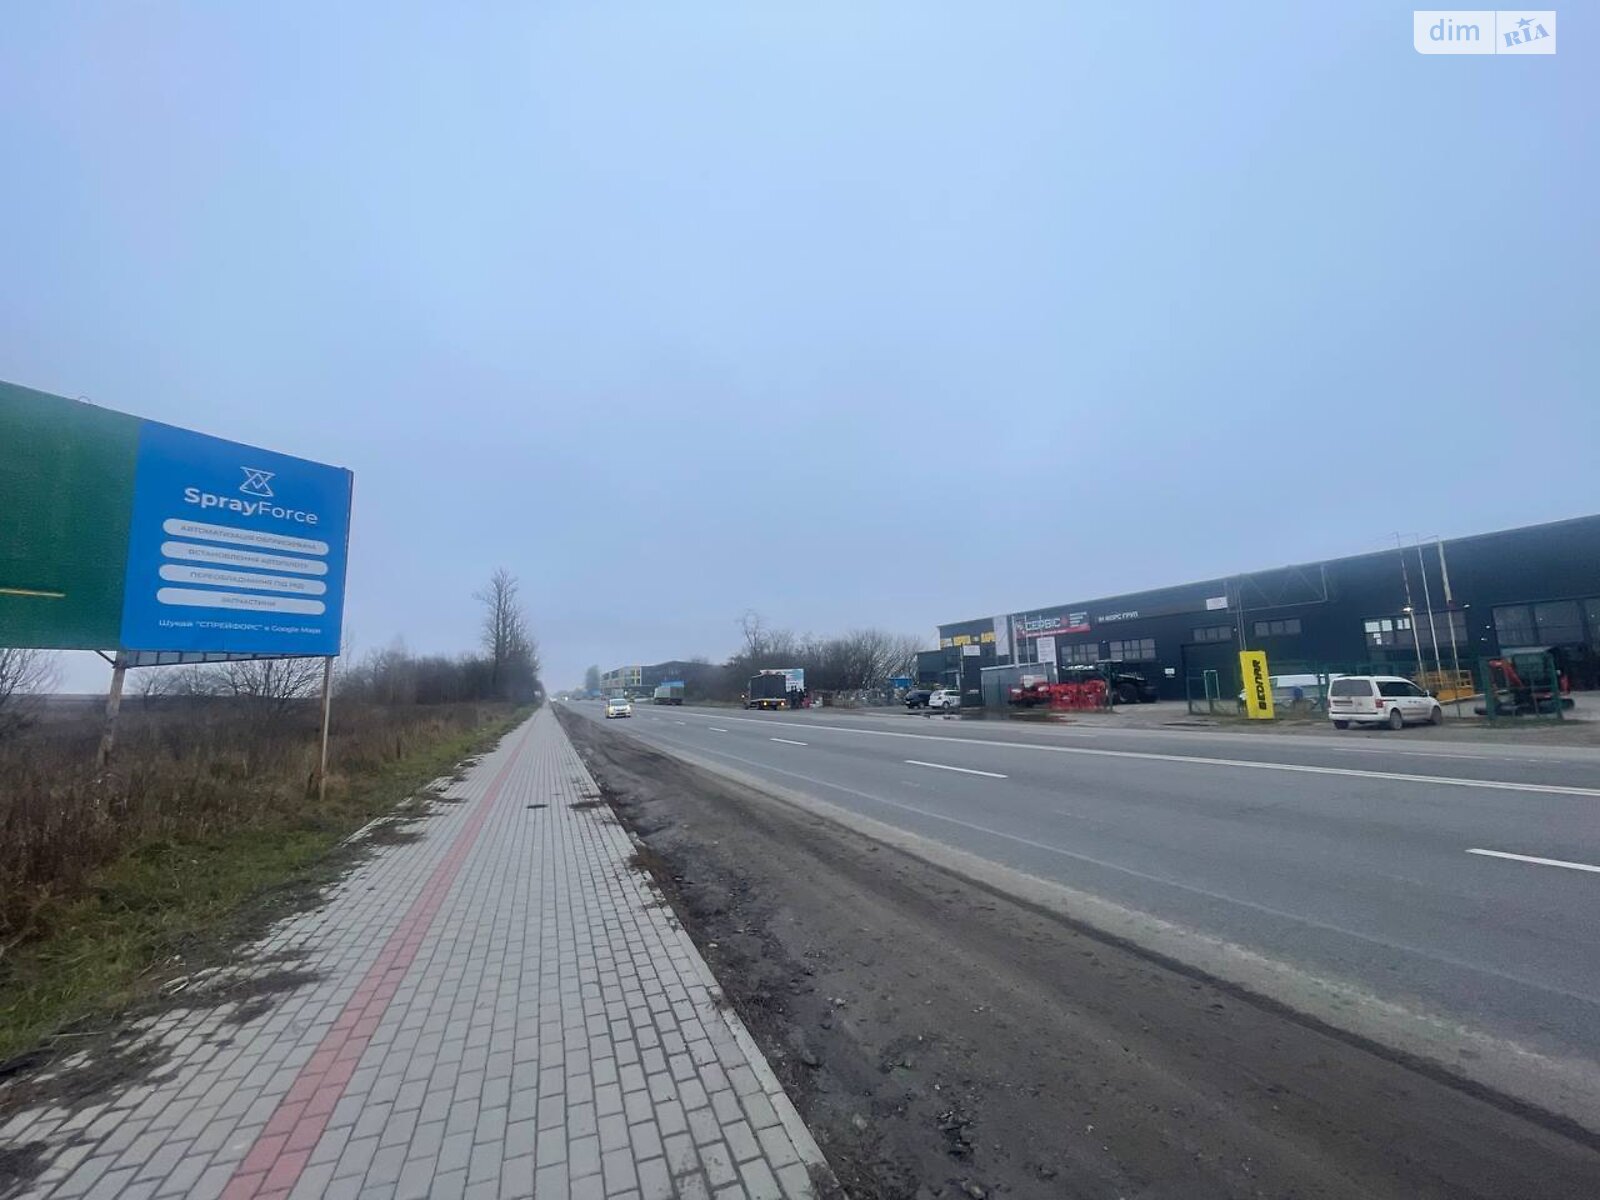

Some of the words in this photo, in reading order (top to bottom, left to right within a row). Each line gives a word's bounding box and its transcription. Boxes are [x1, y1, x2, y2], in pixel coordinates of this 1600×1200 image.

[184, 487, 319, 526] SprayForce
[159, 619, 194, 628] Шукай
[271, 625, 299, 634] Google
[1252, 659, 1267, 710] BEDNAR
